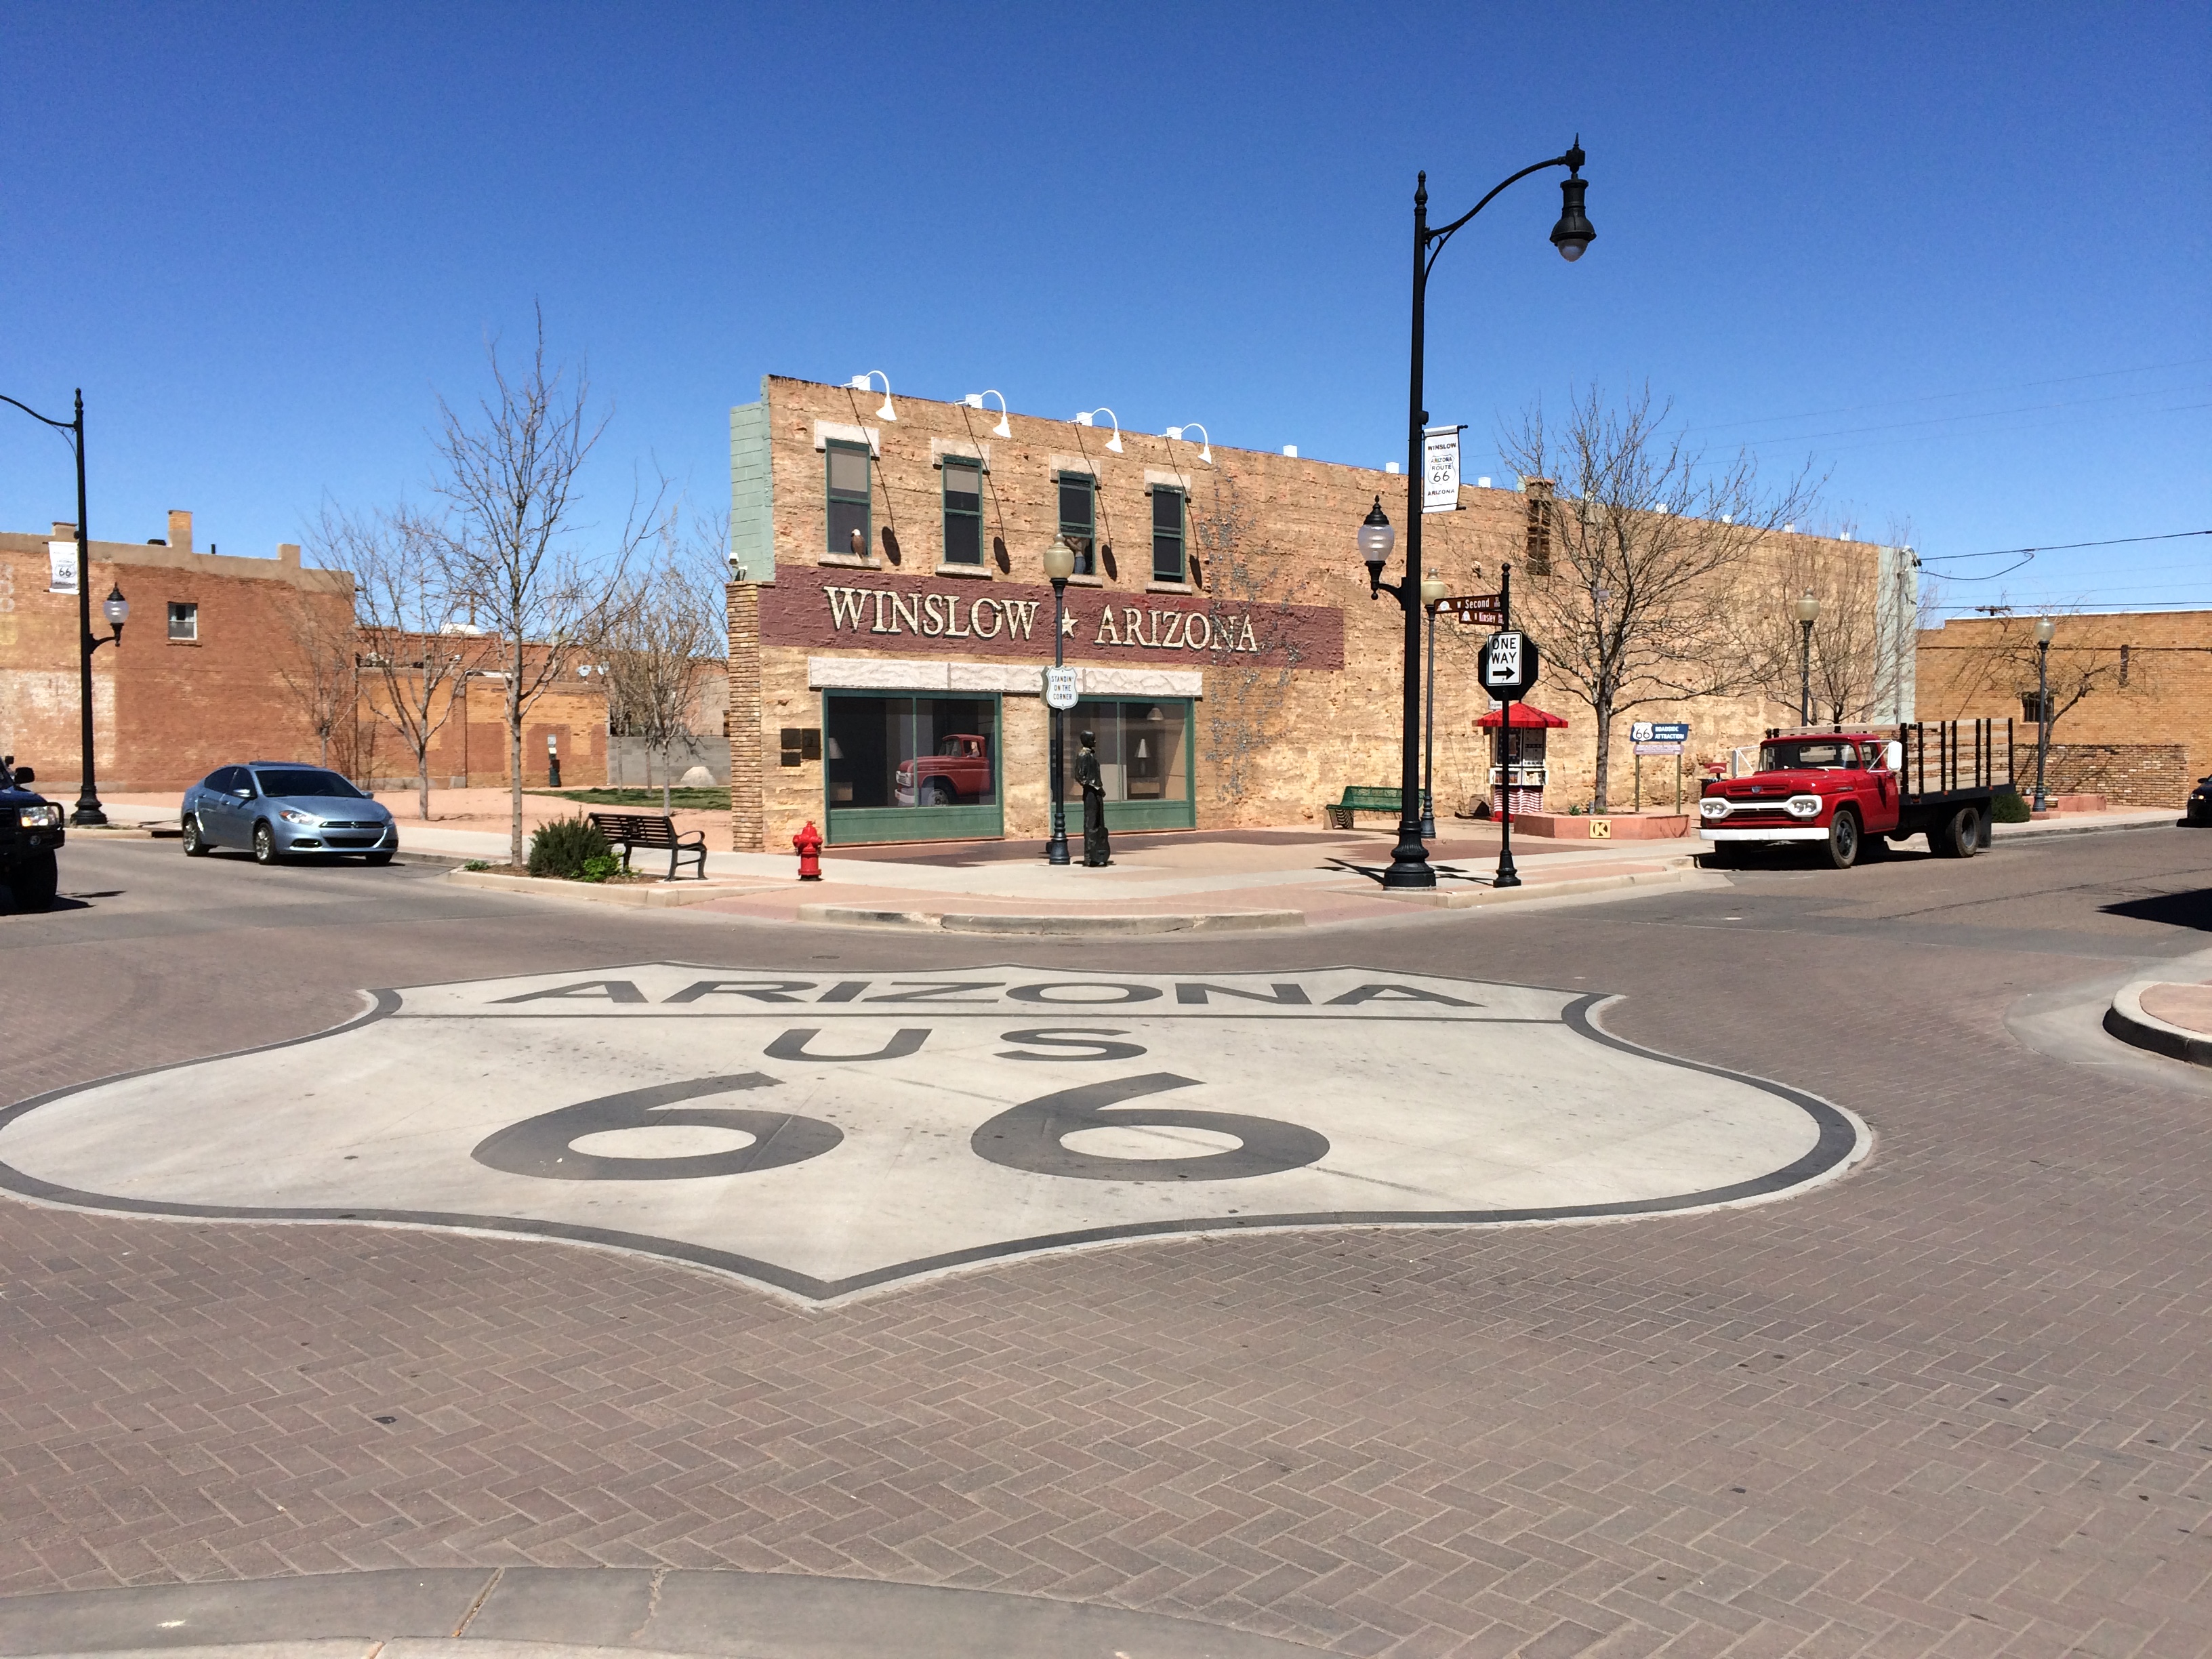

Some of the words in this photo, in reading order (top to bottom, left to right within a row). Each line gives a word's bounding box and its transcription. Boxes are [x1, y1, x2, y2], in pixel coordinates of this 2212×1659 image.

[1427, 443, 1456, 451] WINSLOW
[1433, 471, 1450, 482] 66
[59, 567, 71, 576] 66
[1465, 598, 1490, 609] Second
[823, 586, 1040, 640] WINSLOW
[1094, 604, 1258, 652] ARIZONA
[1479, 612, 1496, 623] Kinsley
[1492, 638, 1517, 650] ONE
[1491, 651, 1517, 664] WAY
[1636, 729, 1650, 739] 66
[1594, 822, 1607, 836] K
[483, 980, 1488, 1008] ARIZONA
[470, 1071, 1331, 1181] 66
